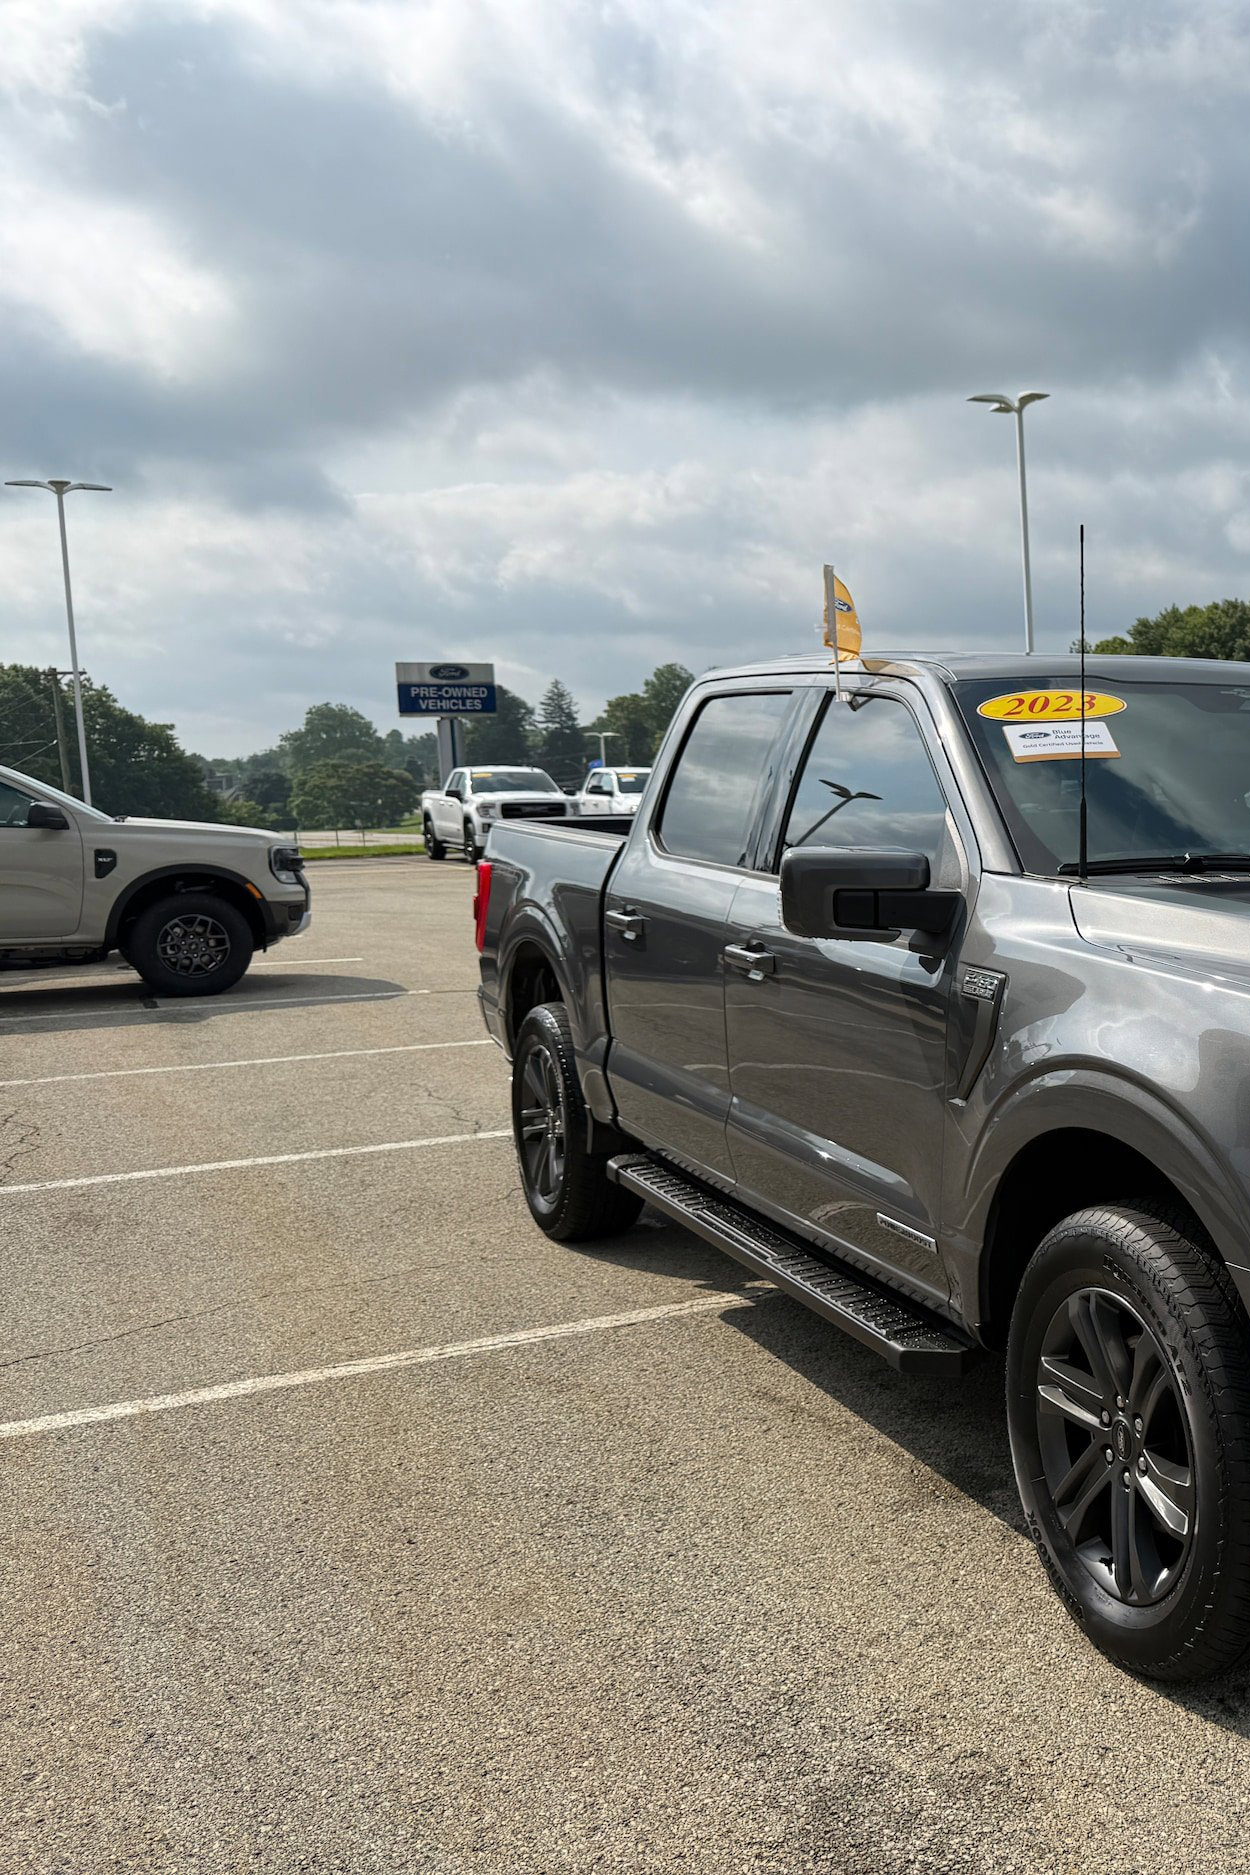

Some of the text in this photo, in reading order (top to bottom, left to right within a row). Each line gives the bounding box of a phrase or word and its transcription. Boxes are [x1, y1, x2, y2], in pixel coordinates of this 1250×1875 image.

[410, 686, 488, 698] PRE-OWNED
[419, 699, 482, 710] VEHICLES
[1002, 694, 1097, 717] 2023
[1053, 732, 1100, 740] Advanage
